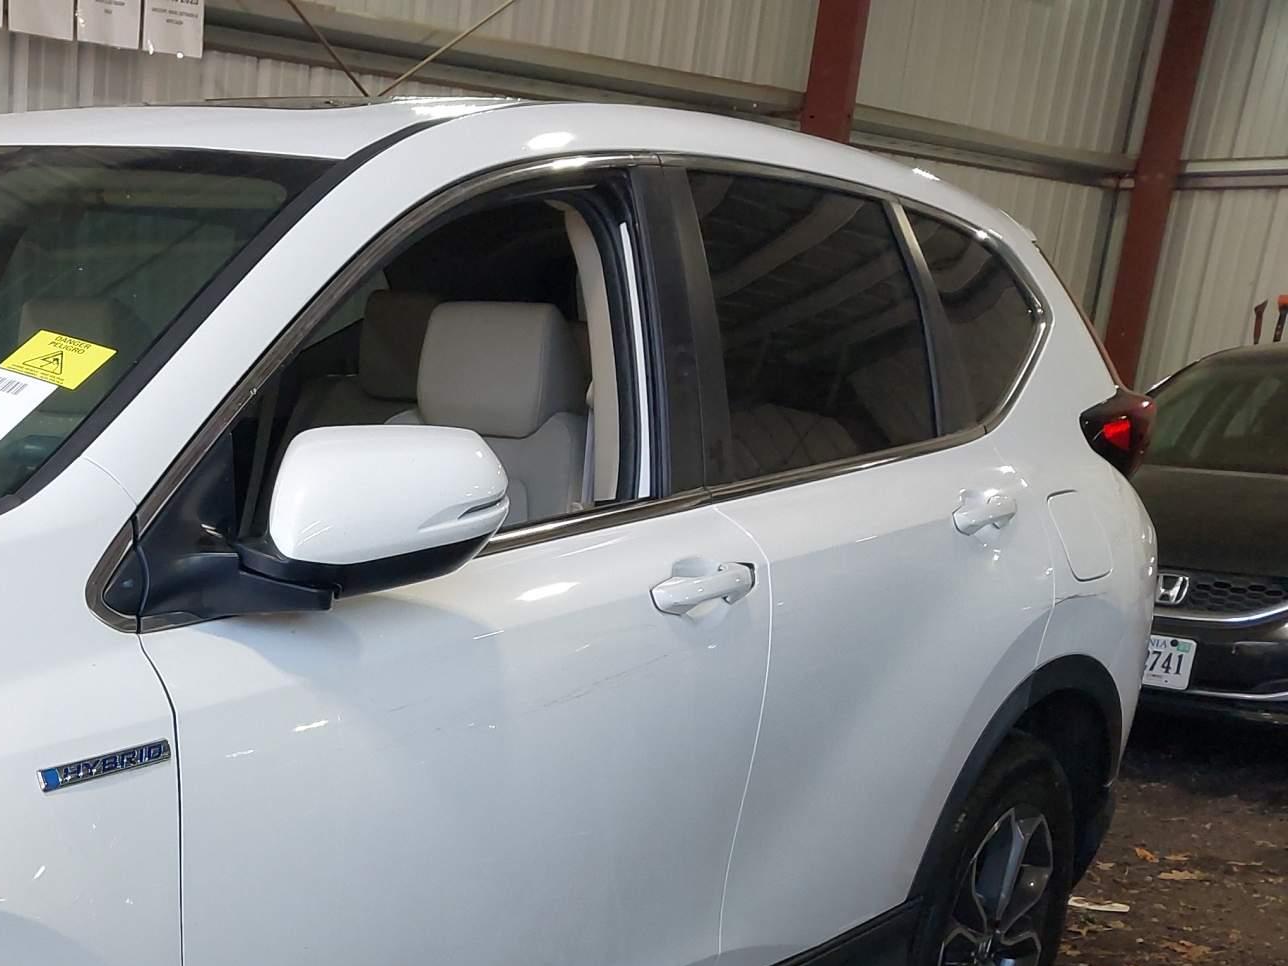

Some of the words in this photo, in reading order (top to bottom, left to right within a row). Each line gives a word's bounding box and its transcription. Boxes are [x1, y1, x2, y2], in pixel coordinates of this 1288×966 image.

[48, 341, 86, 355] PELIGRO
[54, 335, 92, 350] DANGER
[63, 743, 163, 781] HYBRID
